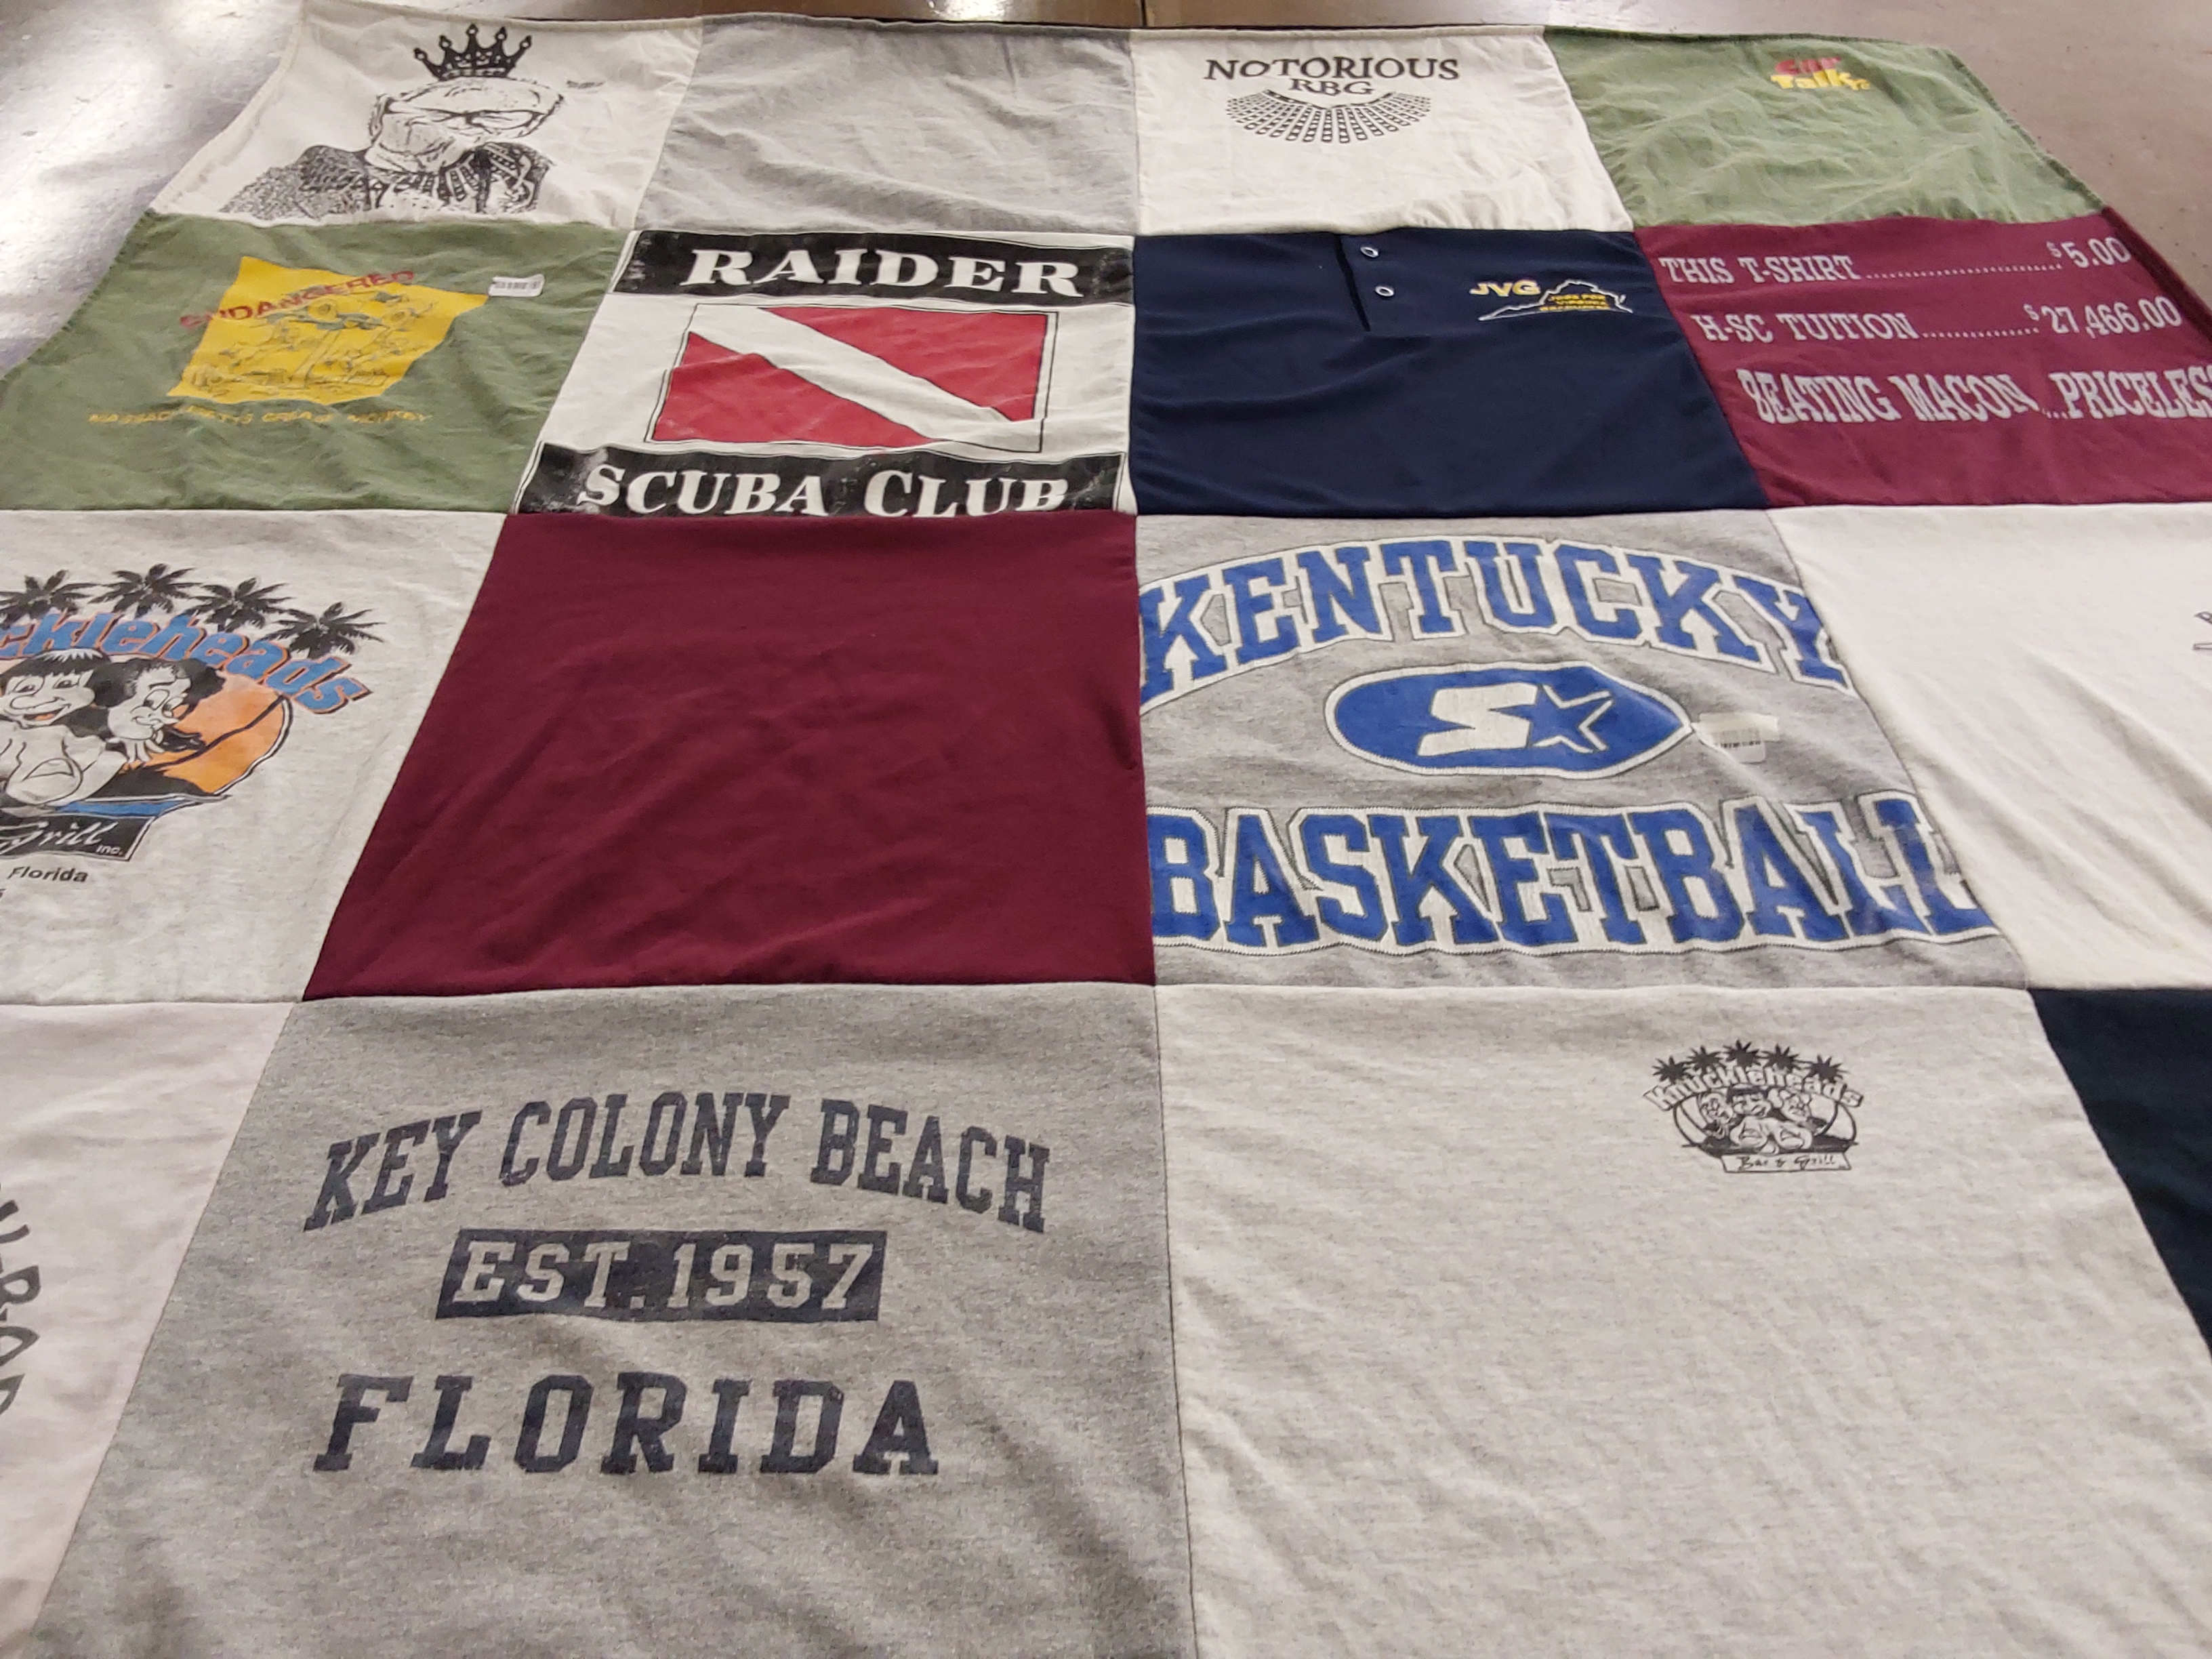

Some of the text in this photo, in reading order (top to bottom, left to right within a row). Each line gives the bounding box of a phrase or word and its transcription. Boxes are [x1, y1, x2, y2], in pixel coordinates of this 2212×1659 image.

[1204, 56, 1460, 81] NOTORIOUS
[1288, 78, 1374, 96] RBG
[680, 247, 1084, 299] RAIDER
[1658, 237, 2132, 283] THIS T-SHIRT $5.00
[179, 270, 415, 329] ENDANGERED
[1469, 279, 1541, 296] JVG
[1690, 295, 2184, 344] H-SC TUITION $27,466.00
[1735, 367, 1902, 424] BEATING
[1886, 372, 2039, 422] MACON
[575, 463, 1069, 518] SCUBA CLUB
[1139, 538, 1851, 710] KENTUCKY
[7, 865, 89, 882] Florida
[1147, 796, 1998, 952] BASKETBALL
[304, 1091, 1050, 1233] KEY COLONY BEACH
[313, 1371, 939, 1476] FLORIDA
